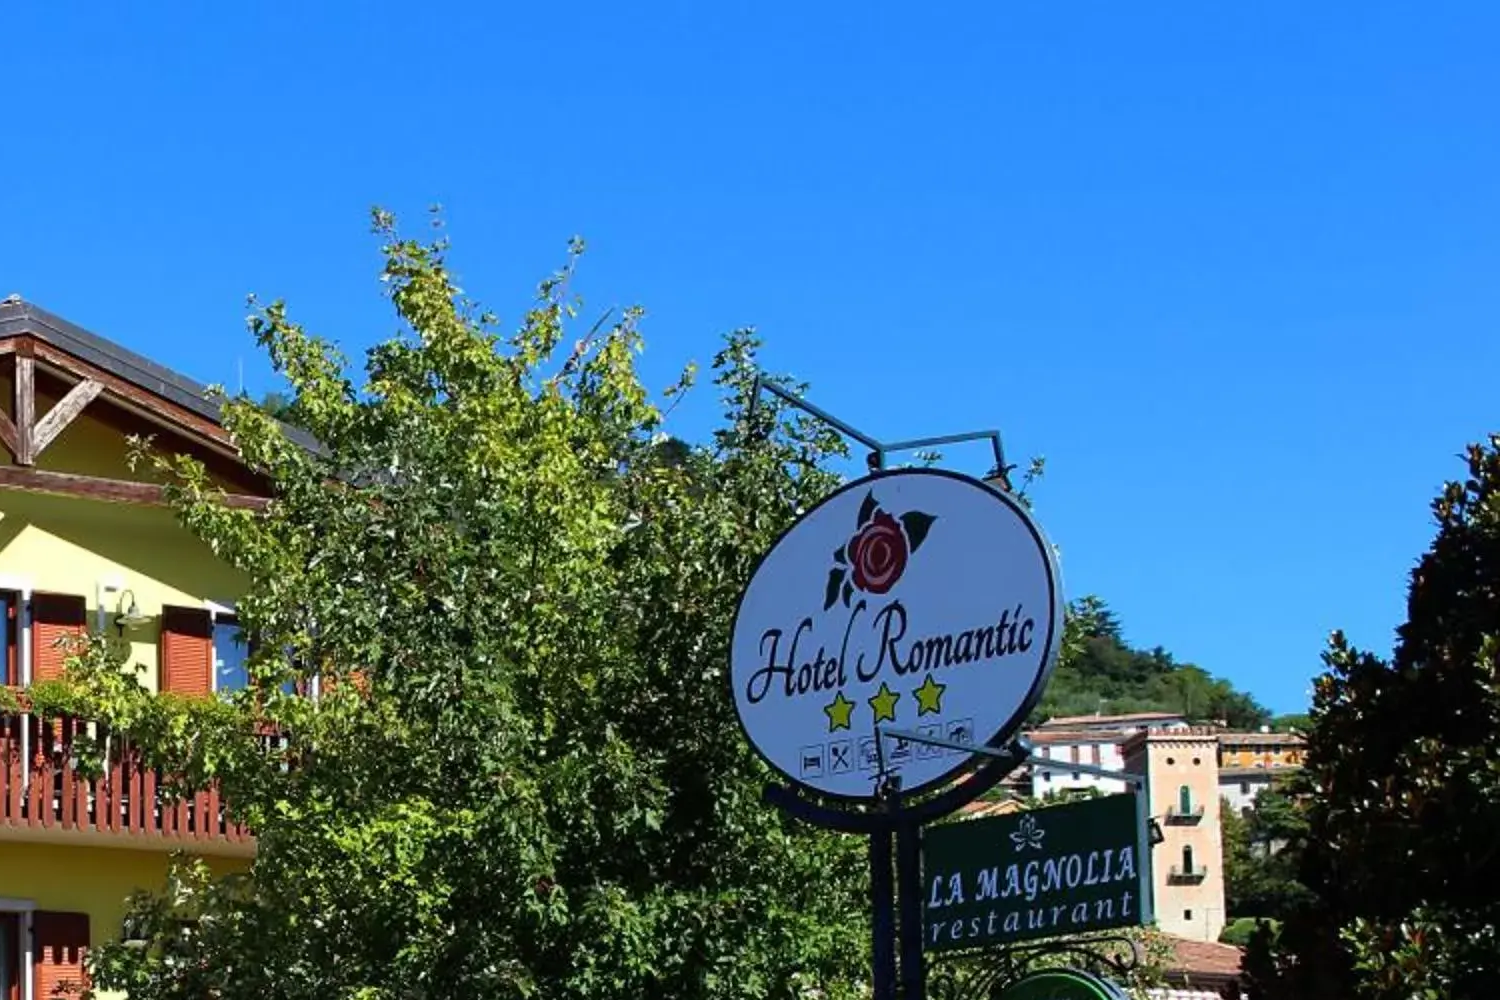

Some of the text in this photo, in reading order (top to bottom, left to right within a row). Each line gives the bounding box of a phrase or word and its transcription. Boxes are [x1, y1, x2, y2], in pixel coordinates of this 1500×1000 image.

[746, 599, 1035, 703] Hotel Romantic
[927, 845, 1137, 908] LA MAGNOLIA
[930, 891, 1133, 943] restaurant
